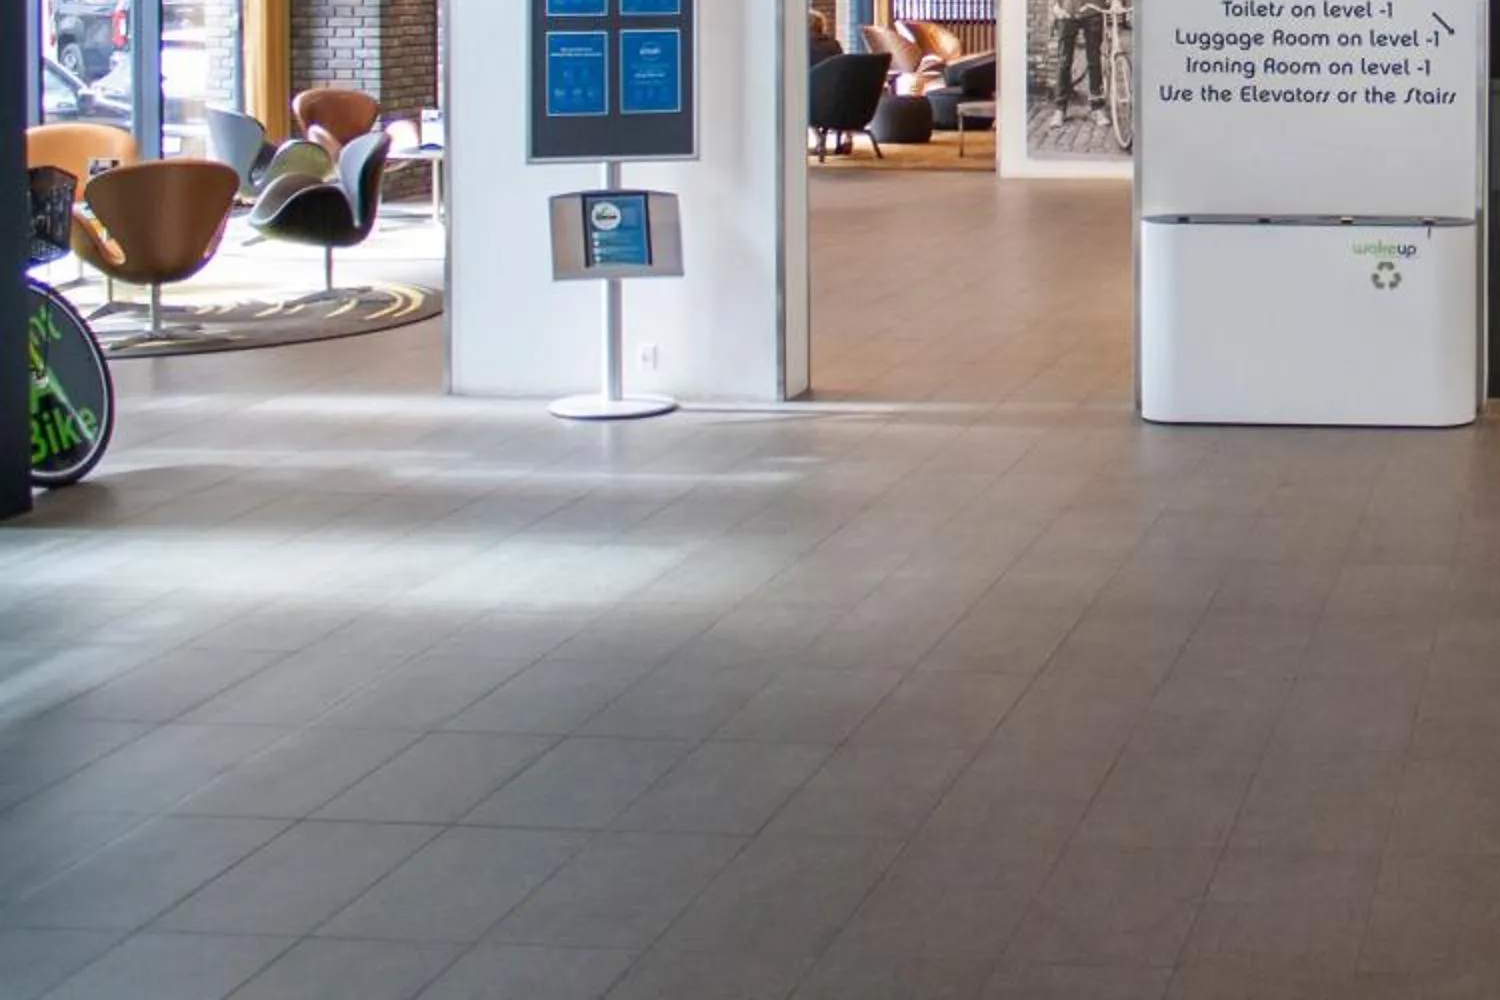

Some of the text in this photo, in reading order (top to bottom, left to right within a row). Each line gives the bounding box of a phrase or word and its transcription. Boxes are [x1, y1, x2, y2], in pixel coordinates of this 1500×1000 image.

[1221, 0, 1393, 19] Toilets on level -1
[1175, 27, 1440, 52] Luggage Room on level -1
[1186, 56, 1431, 80] Ironing Room on level -1
[1159, 84, 1457, 105] Use the Elevators or the Stairs
